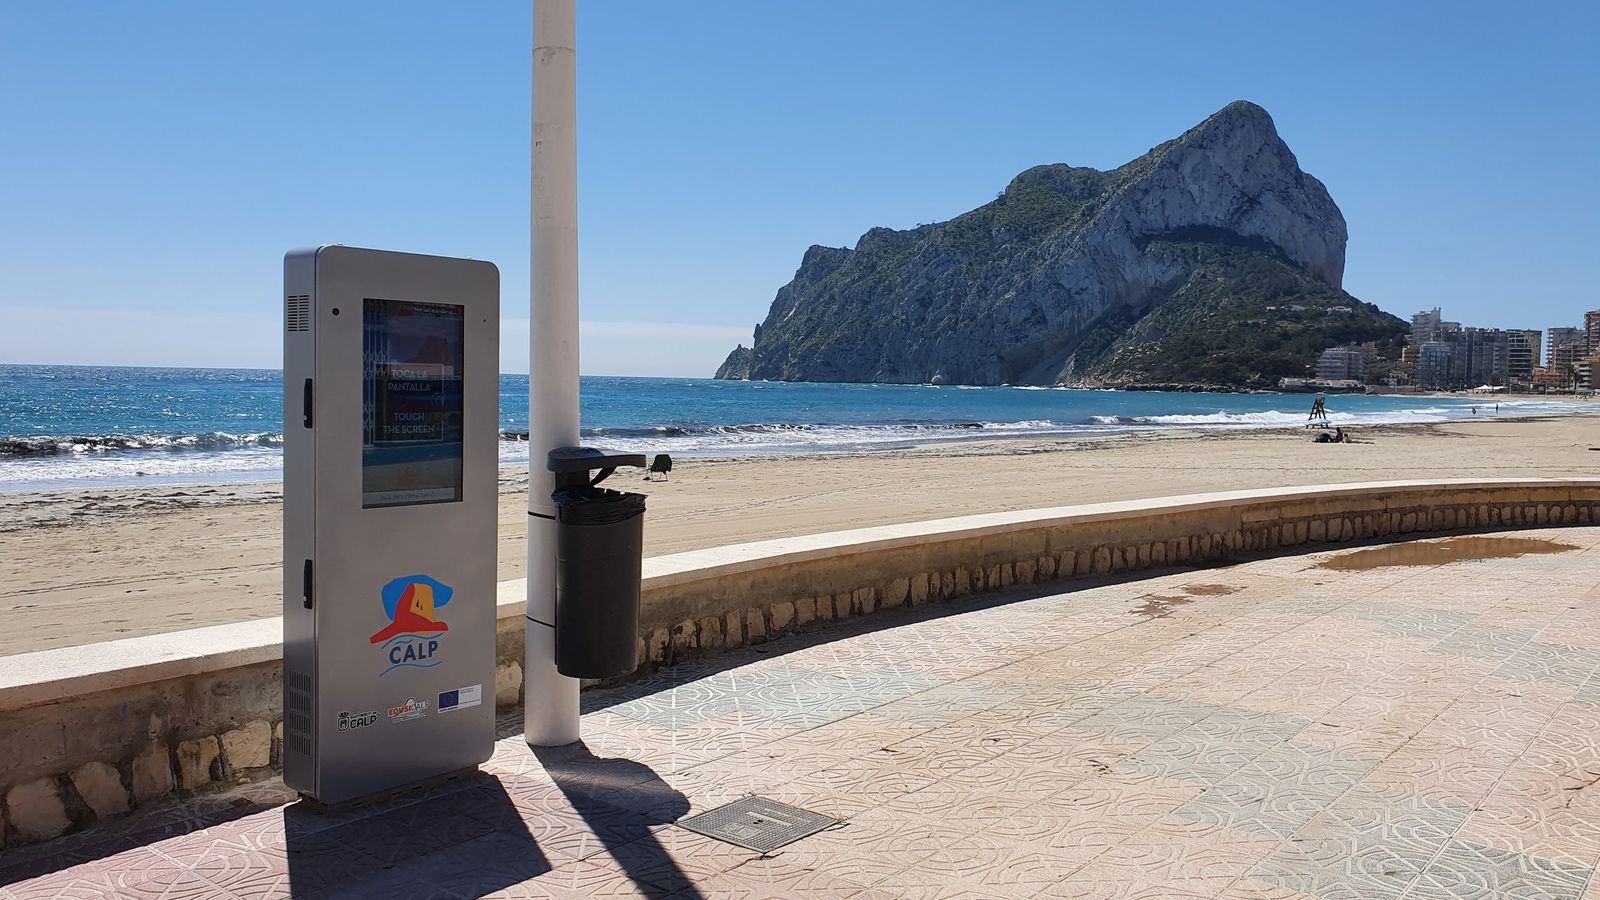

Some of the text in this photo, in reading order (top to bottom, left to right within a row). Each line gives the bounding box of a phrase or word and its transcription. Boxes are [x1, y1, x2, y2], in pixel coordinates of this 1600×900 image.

[391, 369, 428, 378] TOCA LA
[388, 382, 431, 391] PANTALLA
[393, 412, 425, 421] TOUCH
[384, 424, 435, 434] THE SCREEN
[389, 640, 438, 664] CALP
[350, 715, 377, 729] CALP
